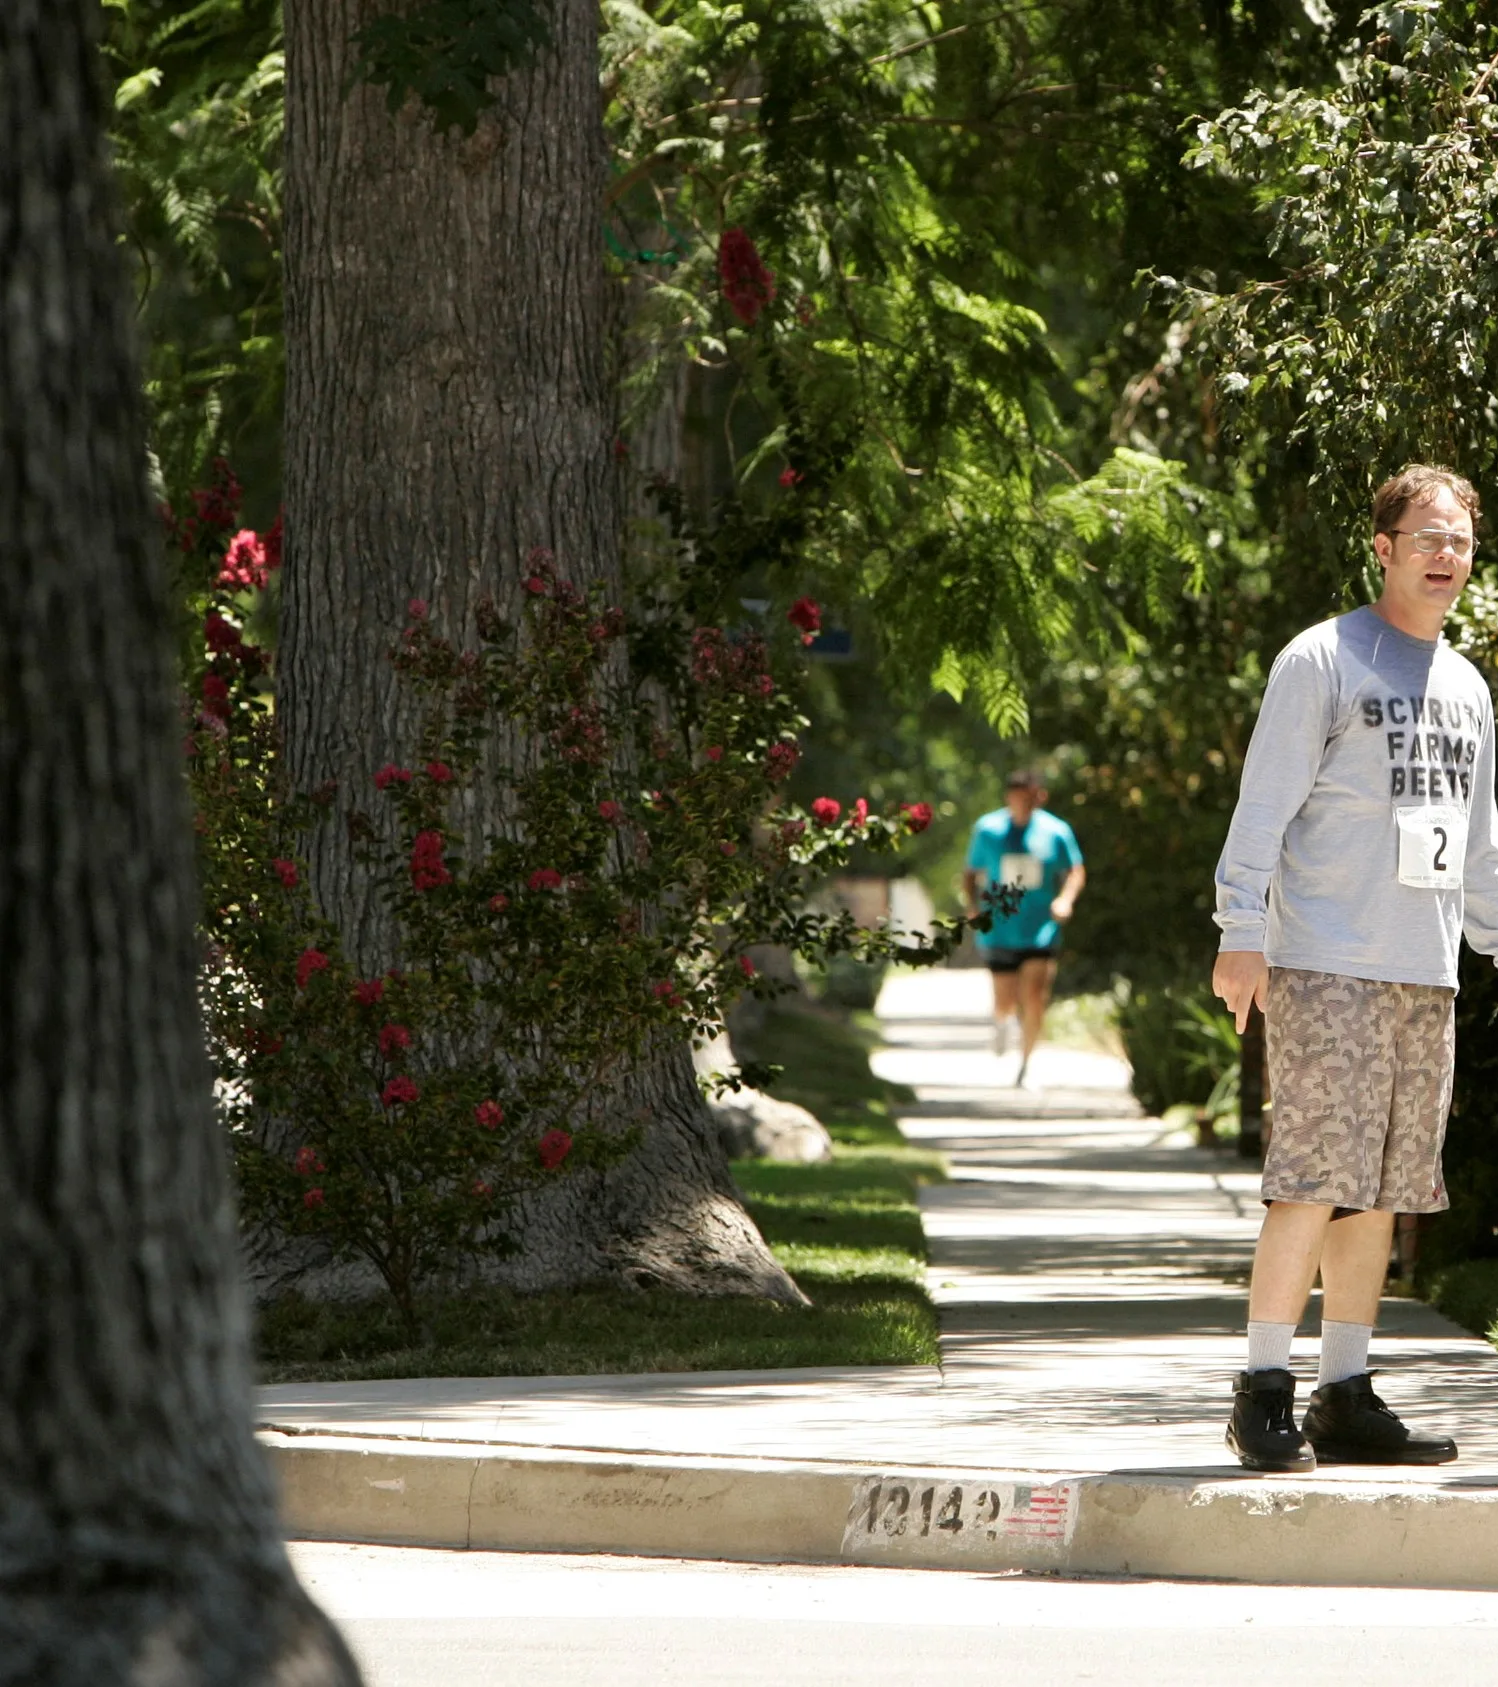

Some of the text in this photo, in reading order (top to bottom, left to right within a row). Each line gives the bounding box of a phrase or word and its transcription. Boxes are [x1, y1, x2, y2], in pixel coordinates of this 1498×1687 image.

[1387, 731, 1477, 764] FARMS
[1391, 767, 1470, 800] BEETS
[1433, 827, 1447, 871] 2
